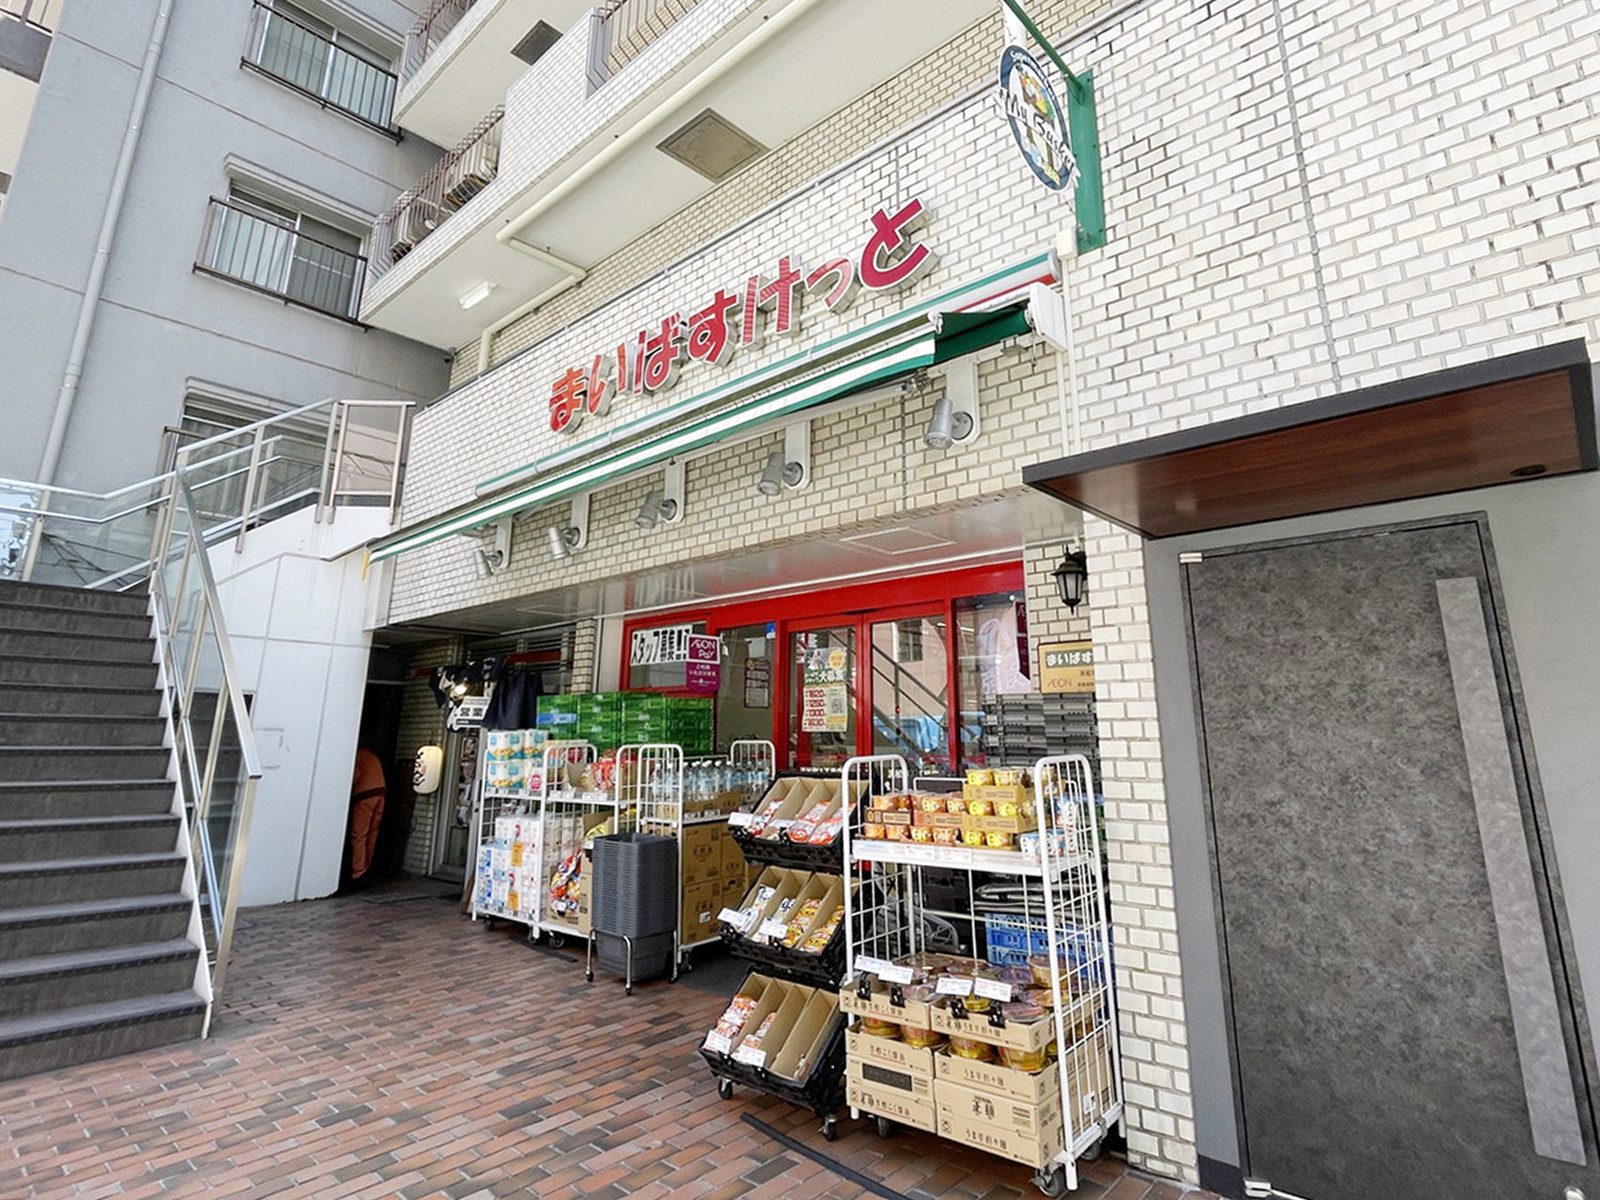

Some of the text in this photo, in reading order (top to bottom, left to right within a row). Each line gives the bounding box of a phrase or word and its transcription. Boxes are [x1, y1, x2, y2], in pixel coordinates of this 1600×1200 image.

[1000, 90, 1028, 125] My
[549, 196, 935, 435] まいばすけっと
